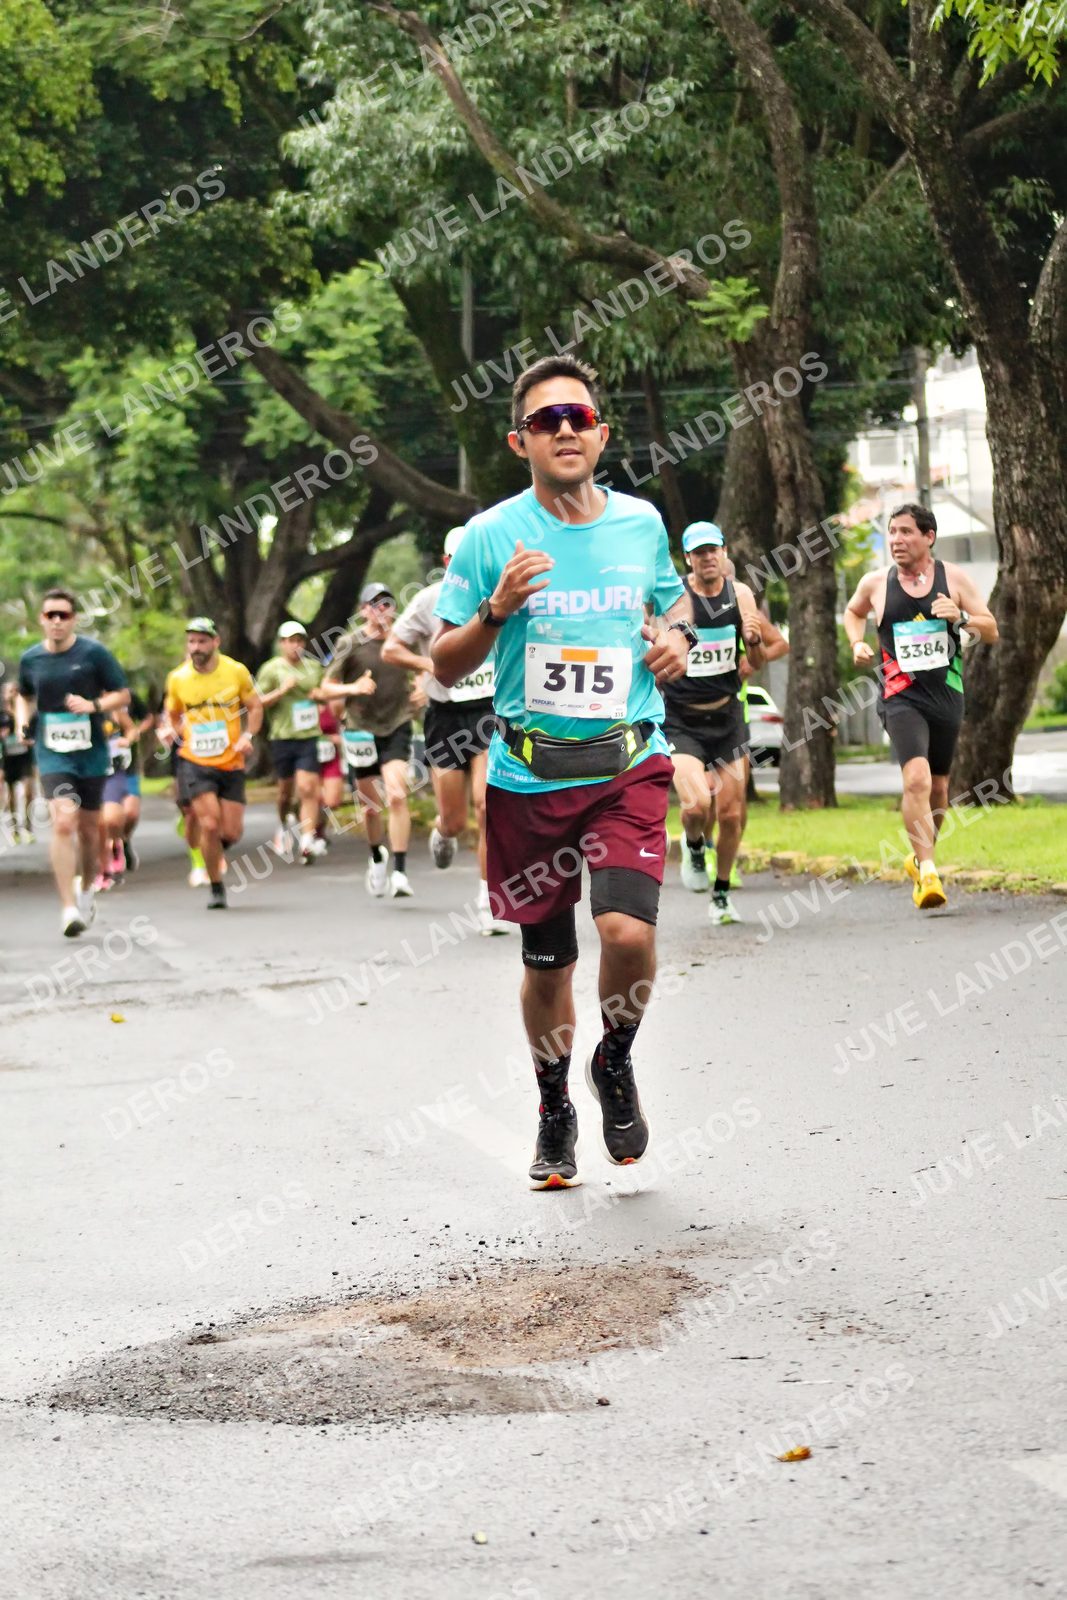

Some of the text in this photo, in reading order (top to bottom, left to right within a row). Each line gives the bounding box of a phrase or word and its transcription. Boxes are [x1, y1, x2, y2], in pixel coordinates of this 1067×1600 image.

[445, 572, 470, 590] URA
[691, 647, 733, 664] 2917
[900, 640, 945, 659] 3384
[543, 662, 614, 694] 315
